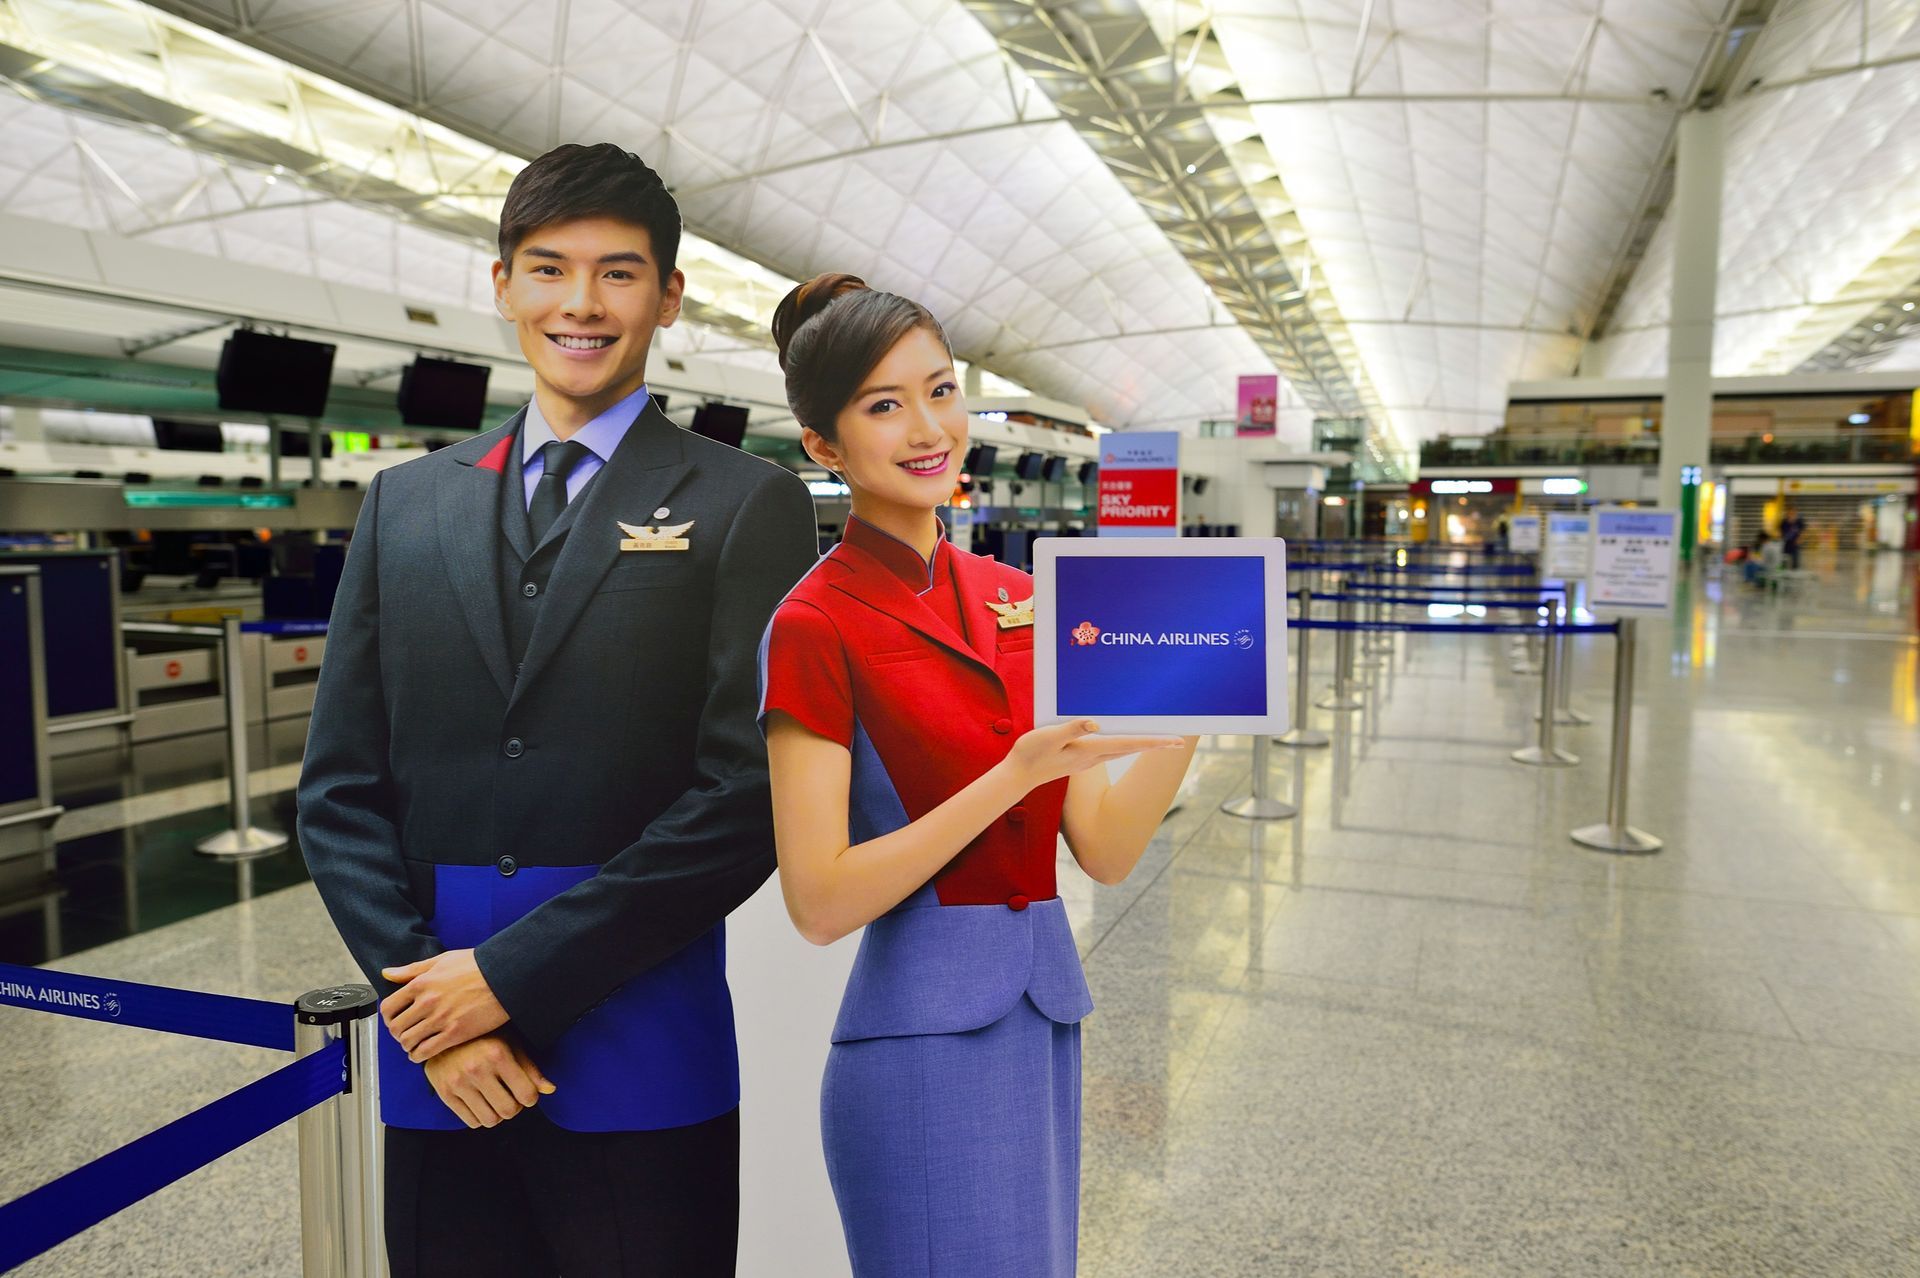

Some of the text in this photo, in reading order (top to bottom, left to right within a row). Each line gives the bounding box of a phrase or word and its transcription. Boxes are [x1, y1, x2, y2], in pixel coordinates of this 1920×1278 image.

[1101, 494, 1132, 506] SKY
[1101, 505, 1171, 518] PRIORITY
[1100, 632, 1154, 646] CHINA
[1157, 632, 1230, 646] AIRLINES
[0, 981, 36, 1000] HINA
[39, 987, 101, 1010] AIRLINES
